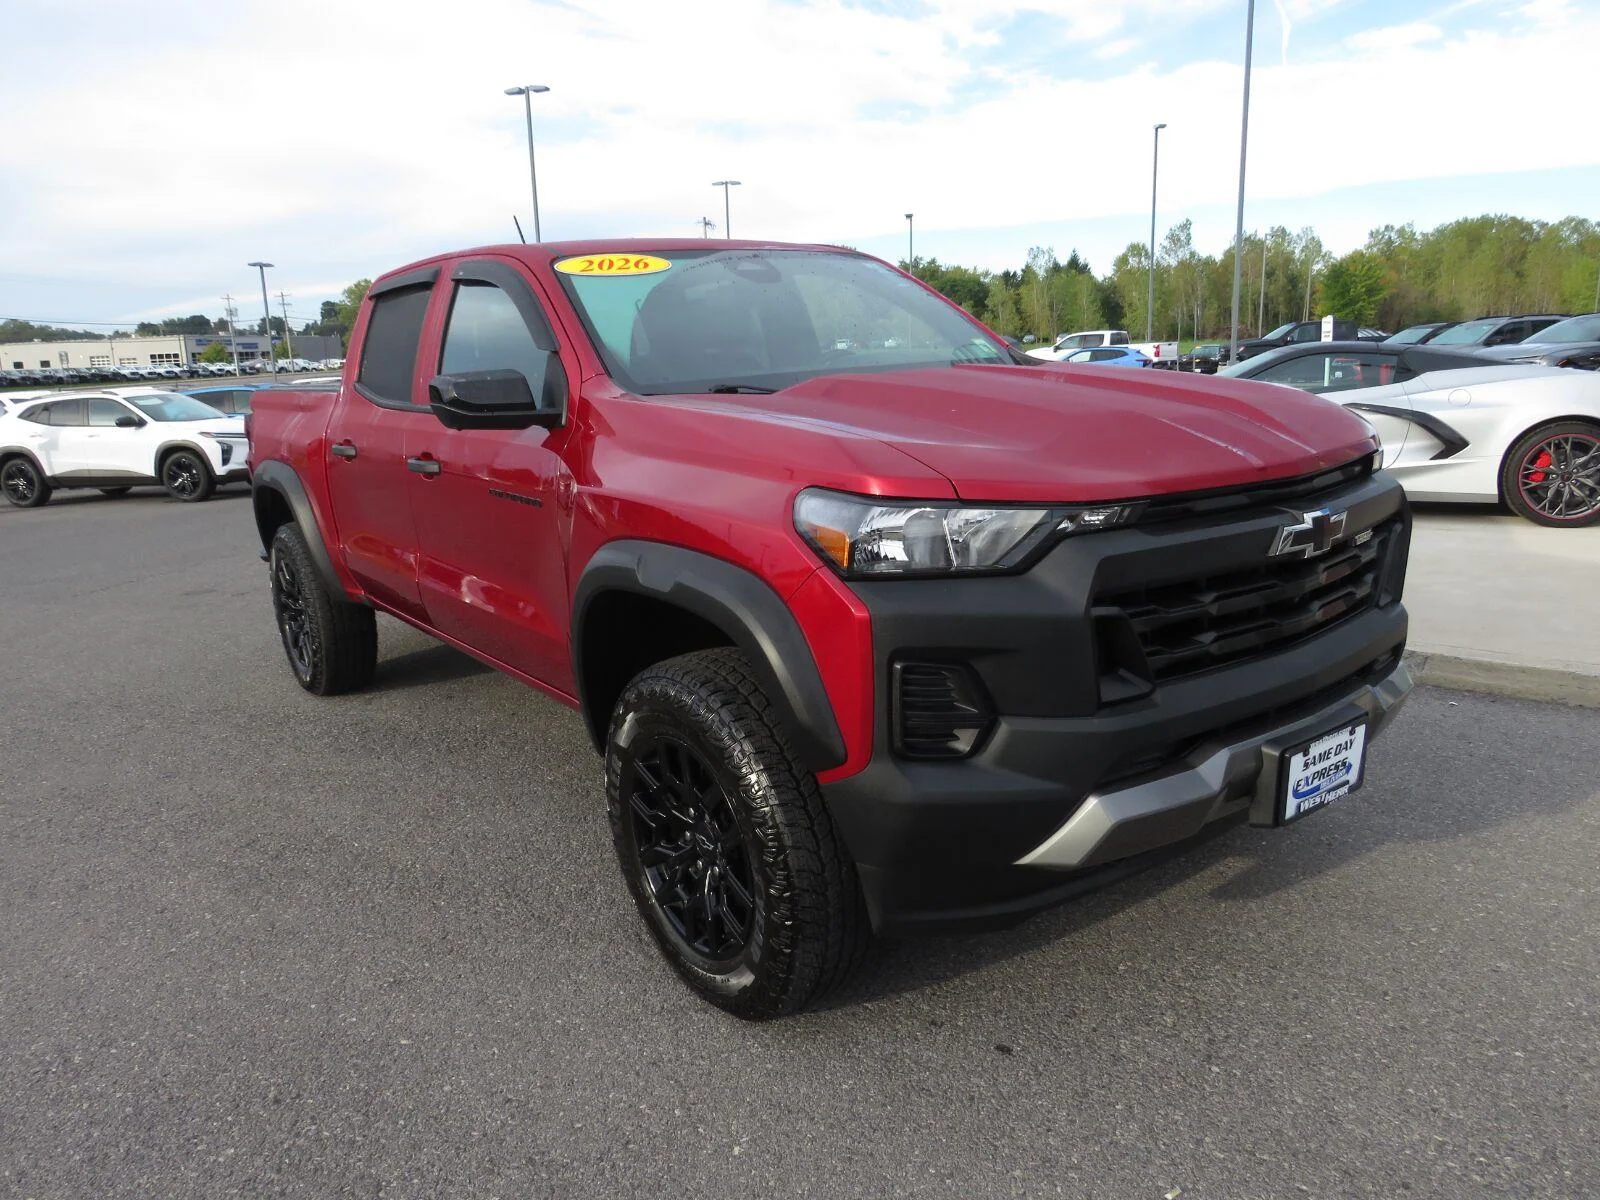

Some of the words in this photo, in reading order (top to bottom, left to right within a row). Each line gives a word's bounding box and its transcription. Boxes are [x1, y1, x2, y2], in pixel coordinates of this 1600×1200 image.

[579, 258, 649, 272] 2026
[1302, 747, 1334, 771] SAME
[1334, 737, 1356, 756] DAY
[1295, 757, 1348, 791] EXPRESS
